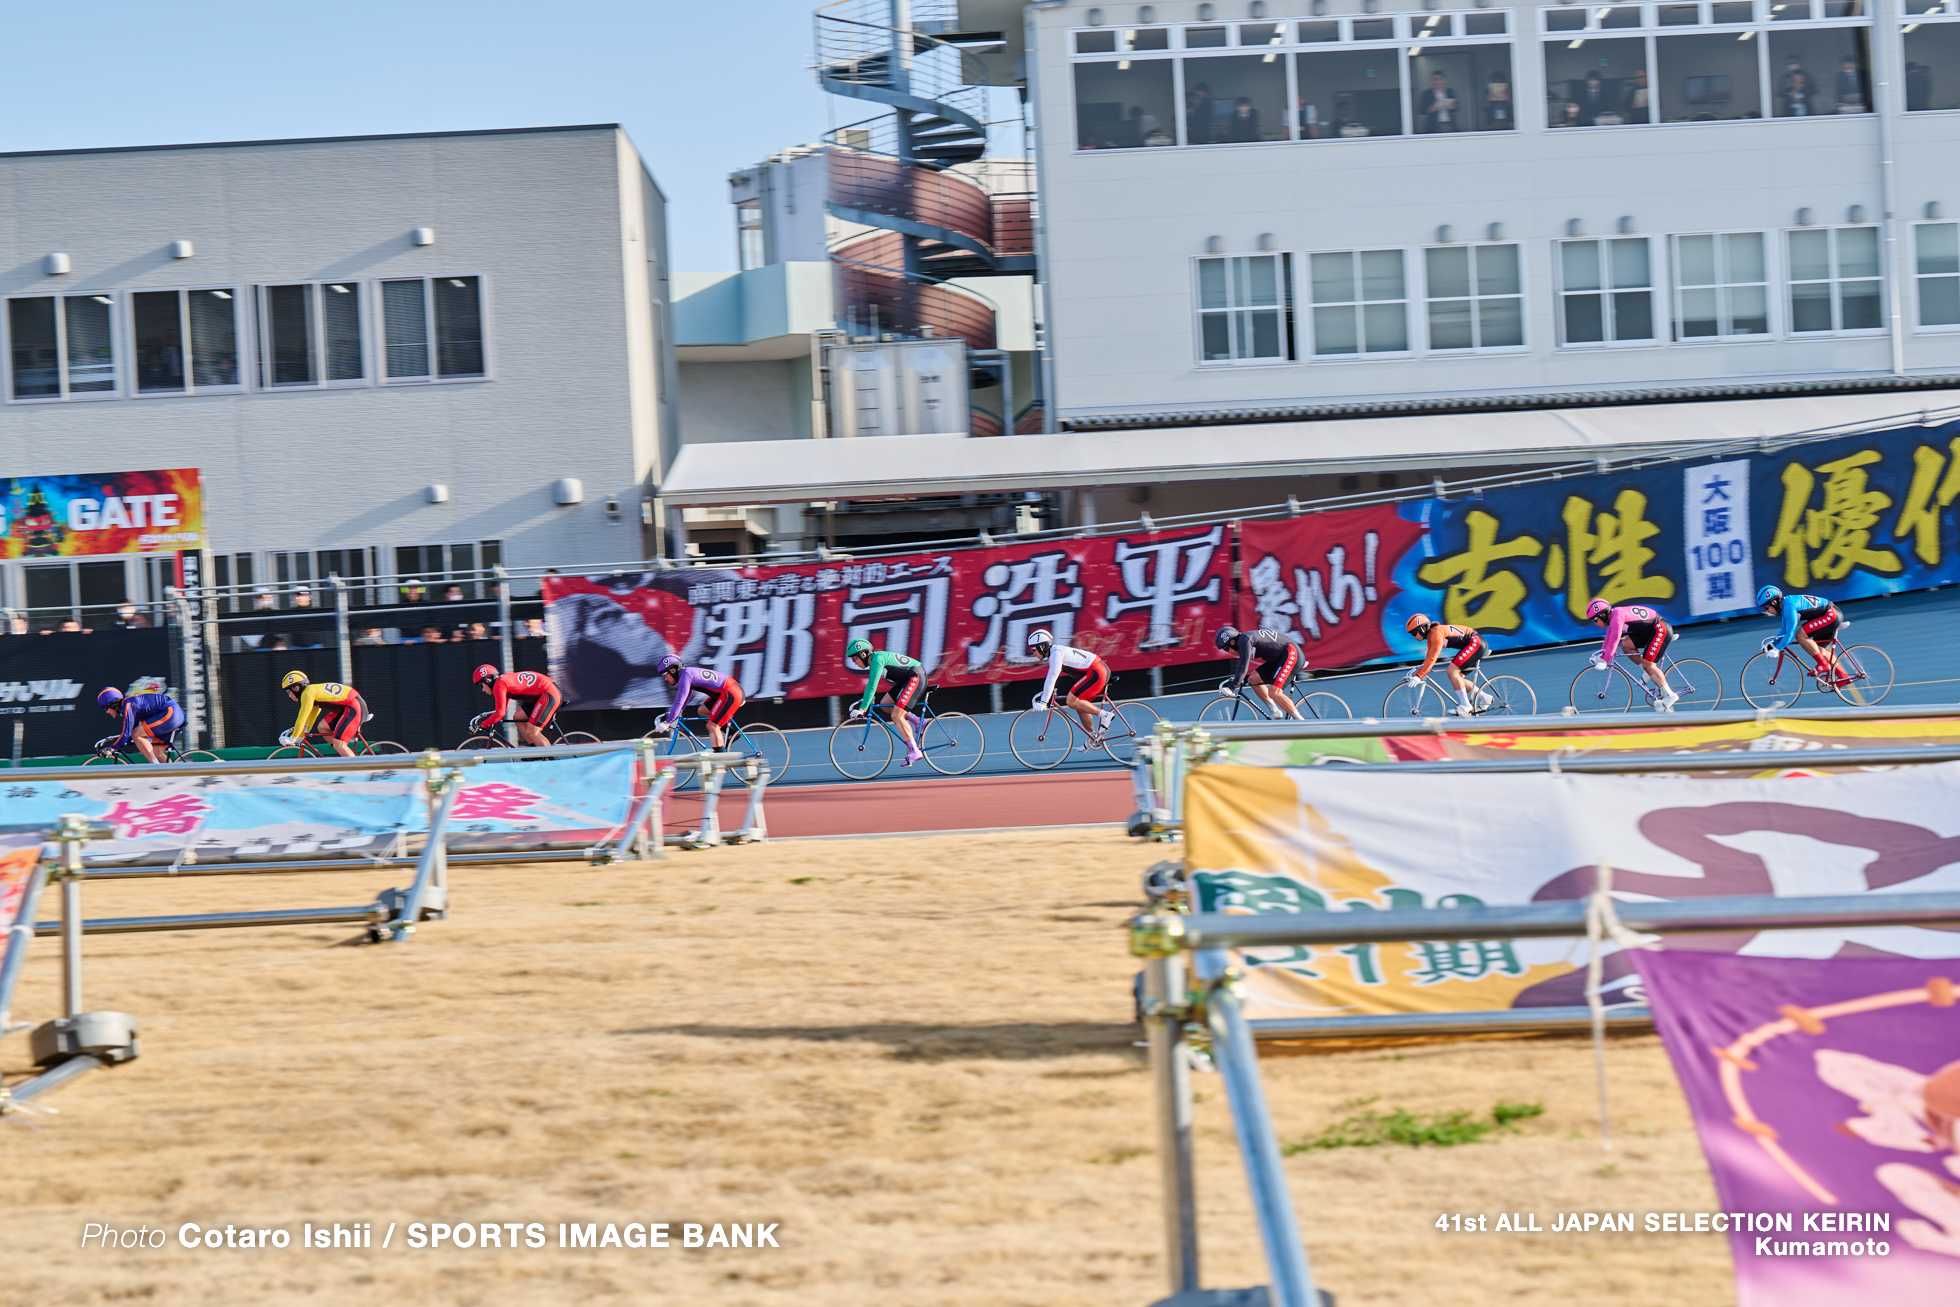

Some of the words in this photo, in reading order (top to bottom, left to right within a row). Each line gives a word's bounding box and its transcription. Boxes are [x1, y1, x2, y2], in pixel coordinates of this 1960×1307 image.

[67, 493, 181, 531] GATE
[1417, 489, 1676, 630] 古性
[1802, 594, 1821, 608] 4
[699, 525, 1224, 699] 郡司浩平
[1631, 606, 1649, 620] 8
[1220, 631, 1230, 643] 2
[1258, 628, 1278, 642] 2
[1448, 624, 1465, 637] 7
[894, 652, 912, 666] 6
[1072, 649, 1088, 660] 1
[517, 671, 537, 687] 3
[700, 669, 718, 683] 9
[323, 682, 343, 697] 5
[531, 702, 542, 719] KEIRIN
